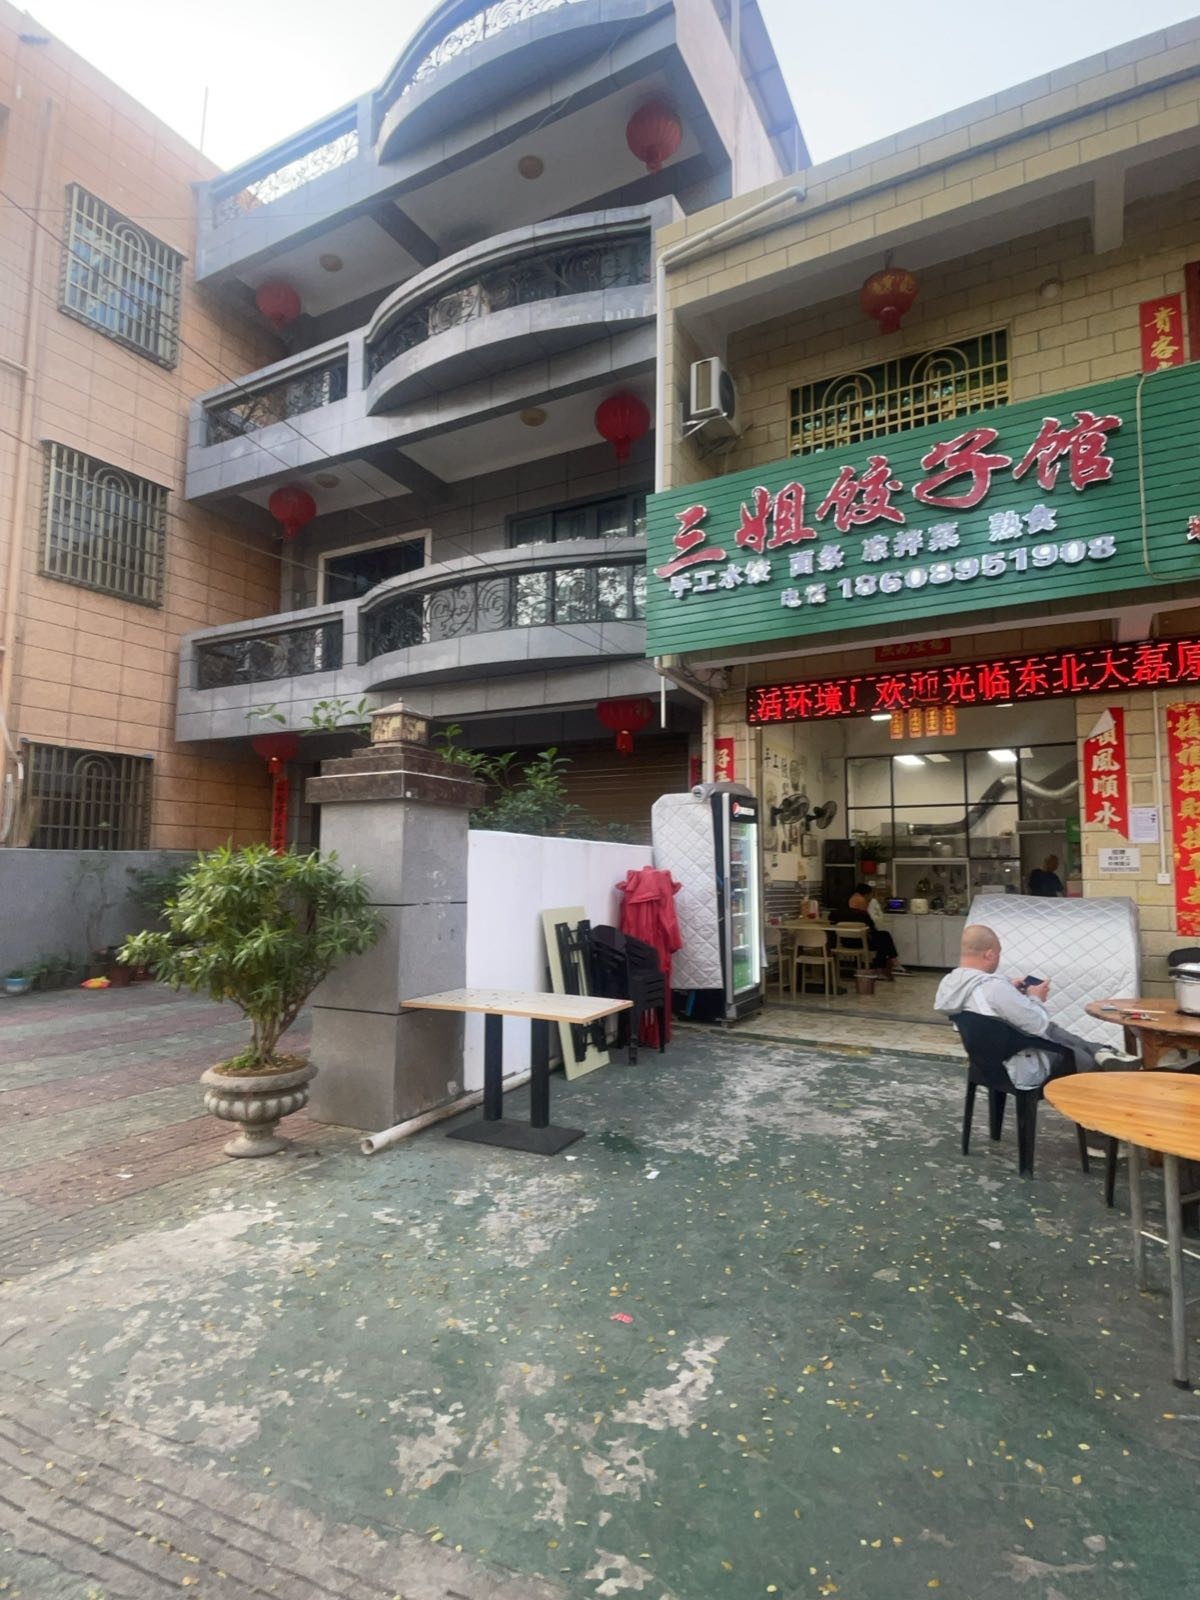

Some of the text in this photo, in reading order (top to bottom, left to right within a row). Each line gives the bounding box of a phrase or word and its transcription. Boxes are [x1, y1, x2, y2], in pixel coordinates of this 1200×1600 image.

[653, 411, 1122, 578] 三姐饺子馆
[669, 504, 1058, 599] 手工水饺 面条 凉拌菜 熟食
[780, 535, 1117, 608] 电话 18608951908
